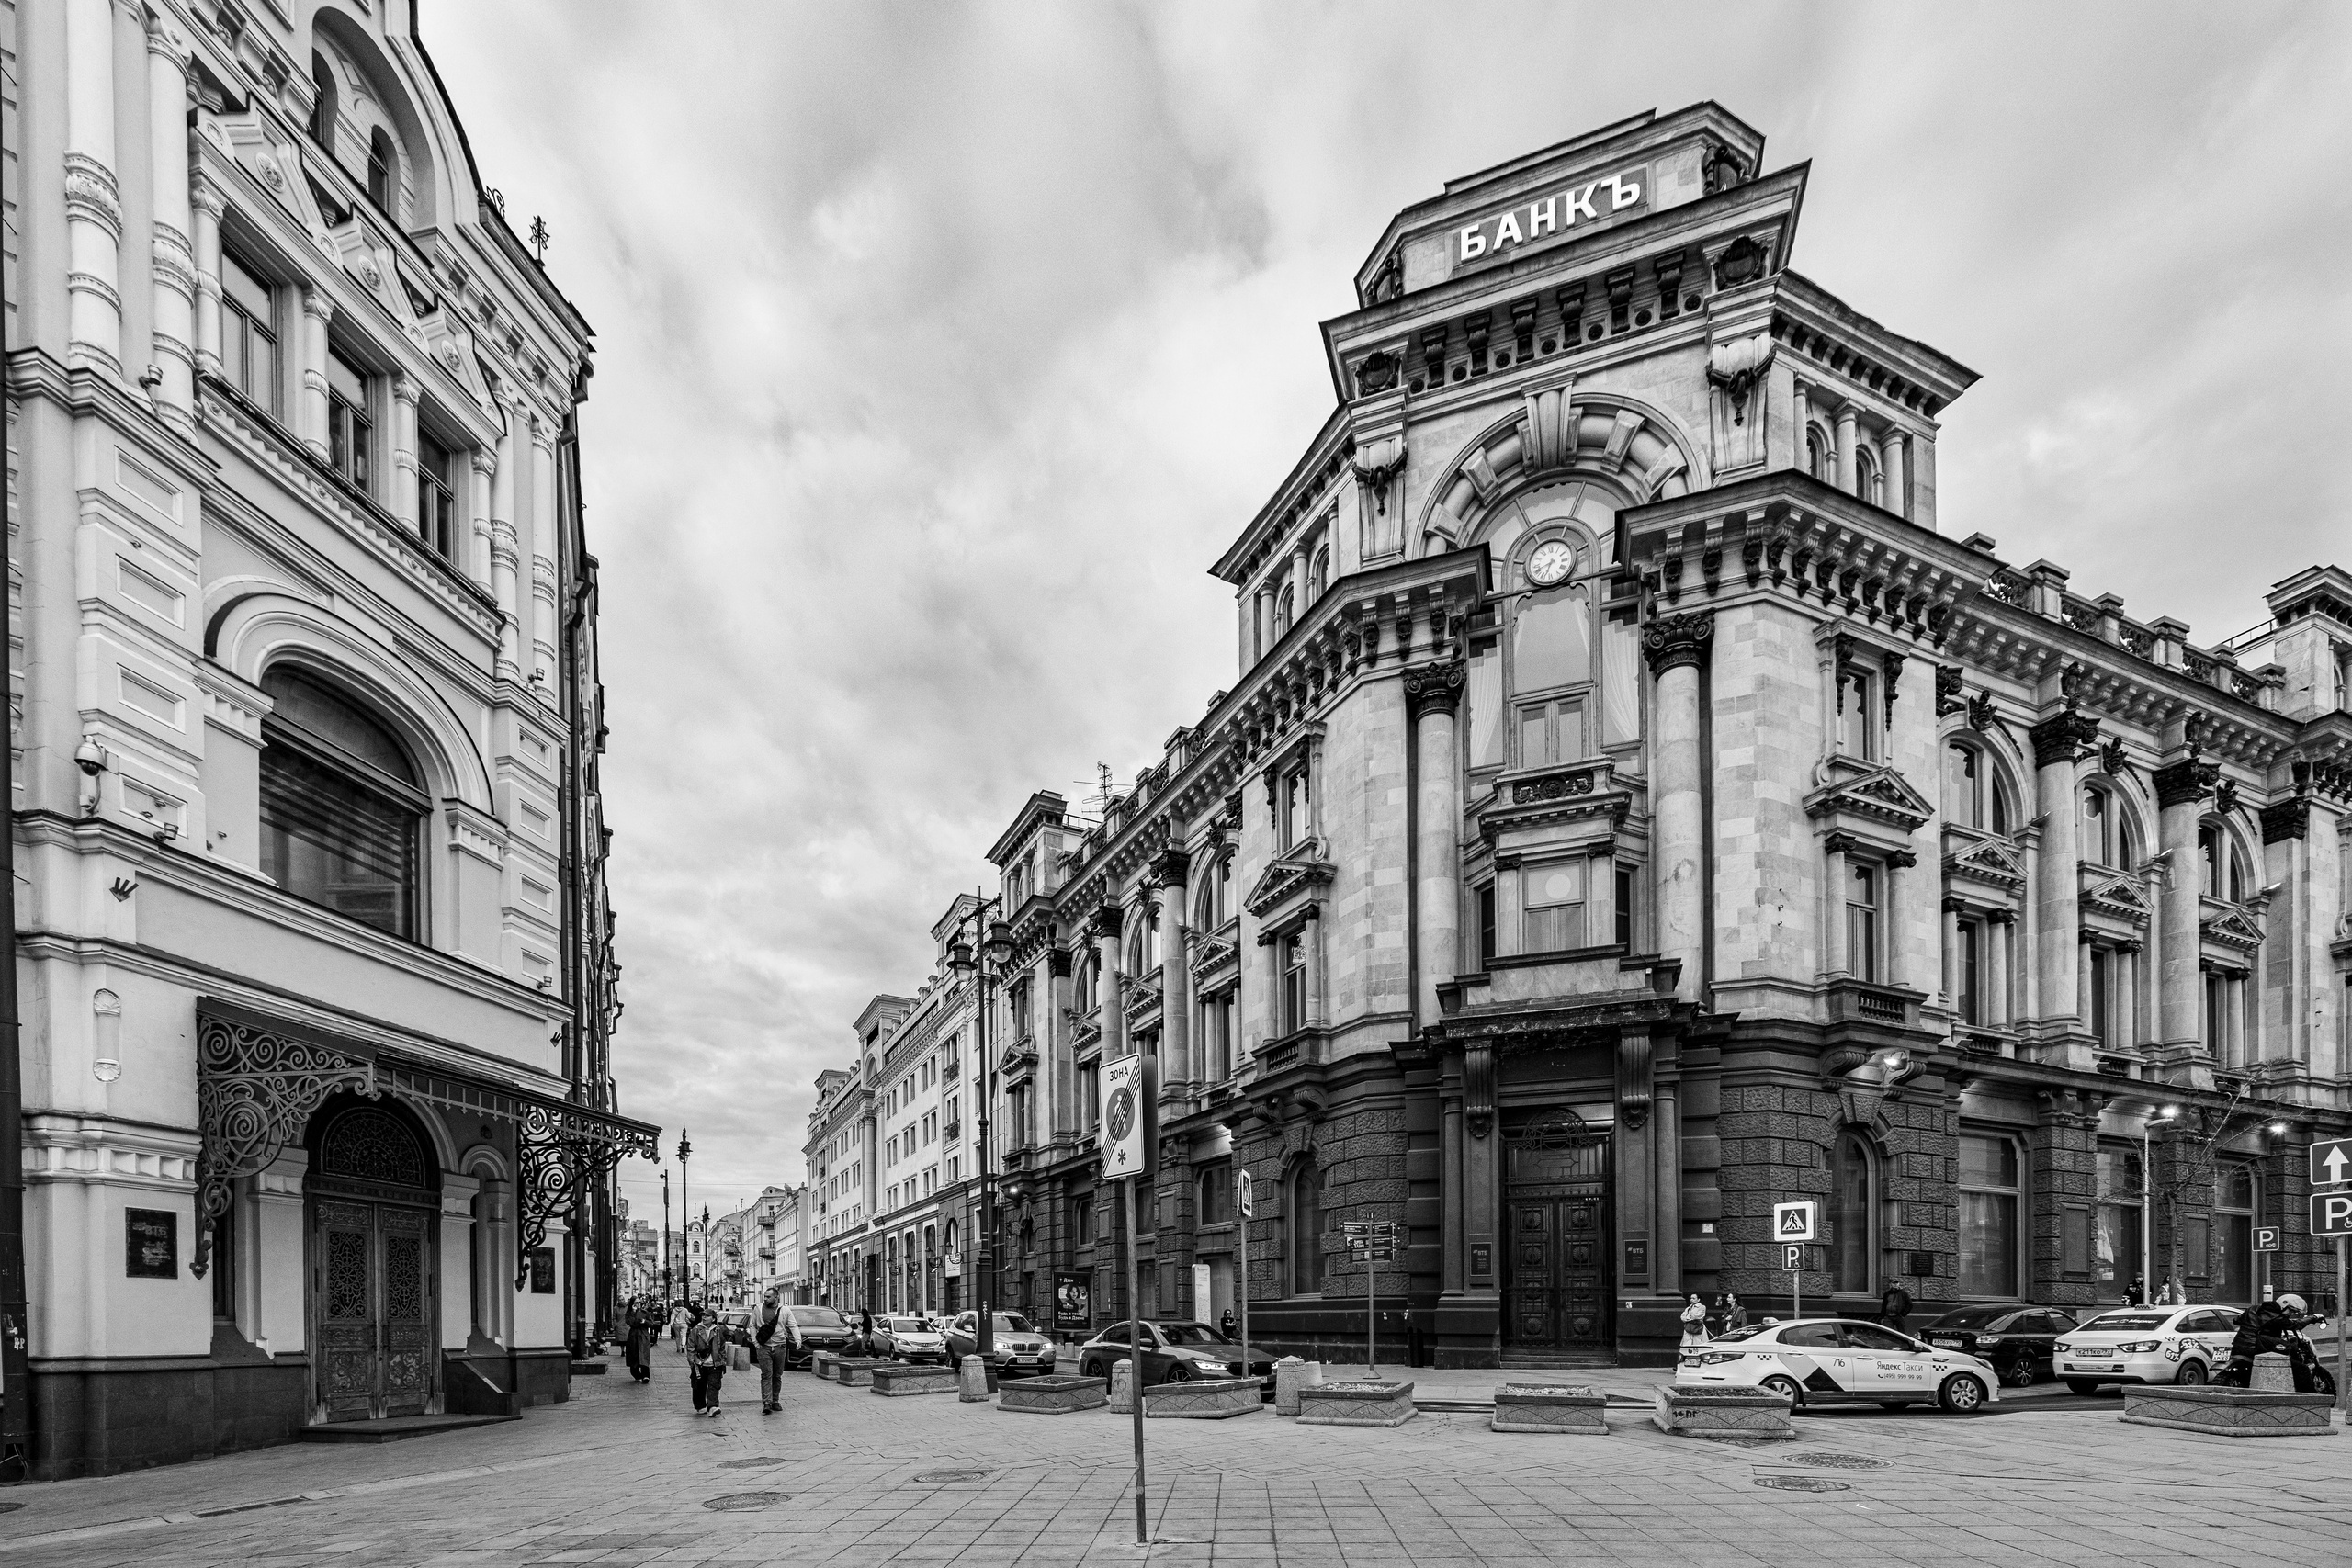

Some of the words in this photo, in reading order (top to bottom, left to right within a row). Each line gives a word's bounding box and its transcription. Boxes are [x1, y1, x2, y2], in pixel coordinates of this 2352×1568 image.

[1460, 174, 1641, 262] БАНКЪ
[1109, 1066, 1129, 1082] ЗОНА
[2325, 1197, 2352, 1230] P
[2259, 1230, 2274, 1248] P
[1787, 1247, 1800, 1268] P
[1832, 1358, 1846, 1368] 716
[2165, 1350, 2180, 1361] 61%
[1876, 1360, 1902, 1371] Яндекс
[1902, 1361, 1924, 1371] Такси
